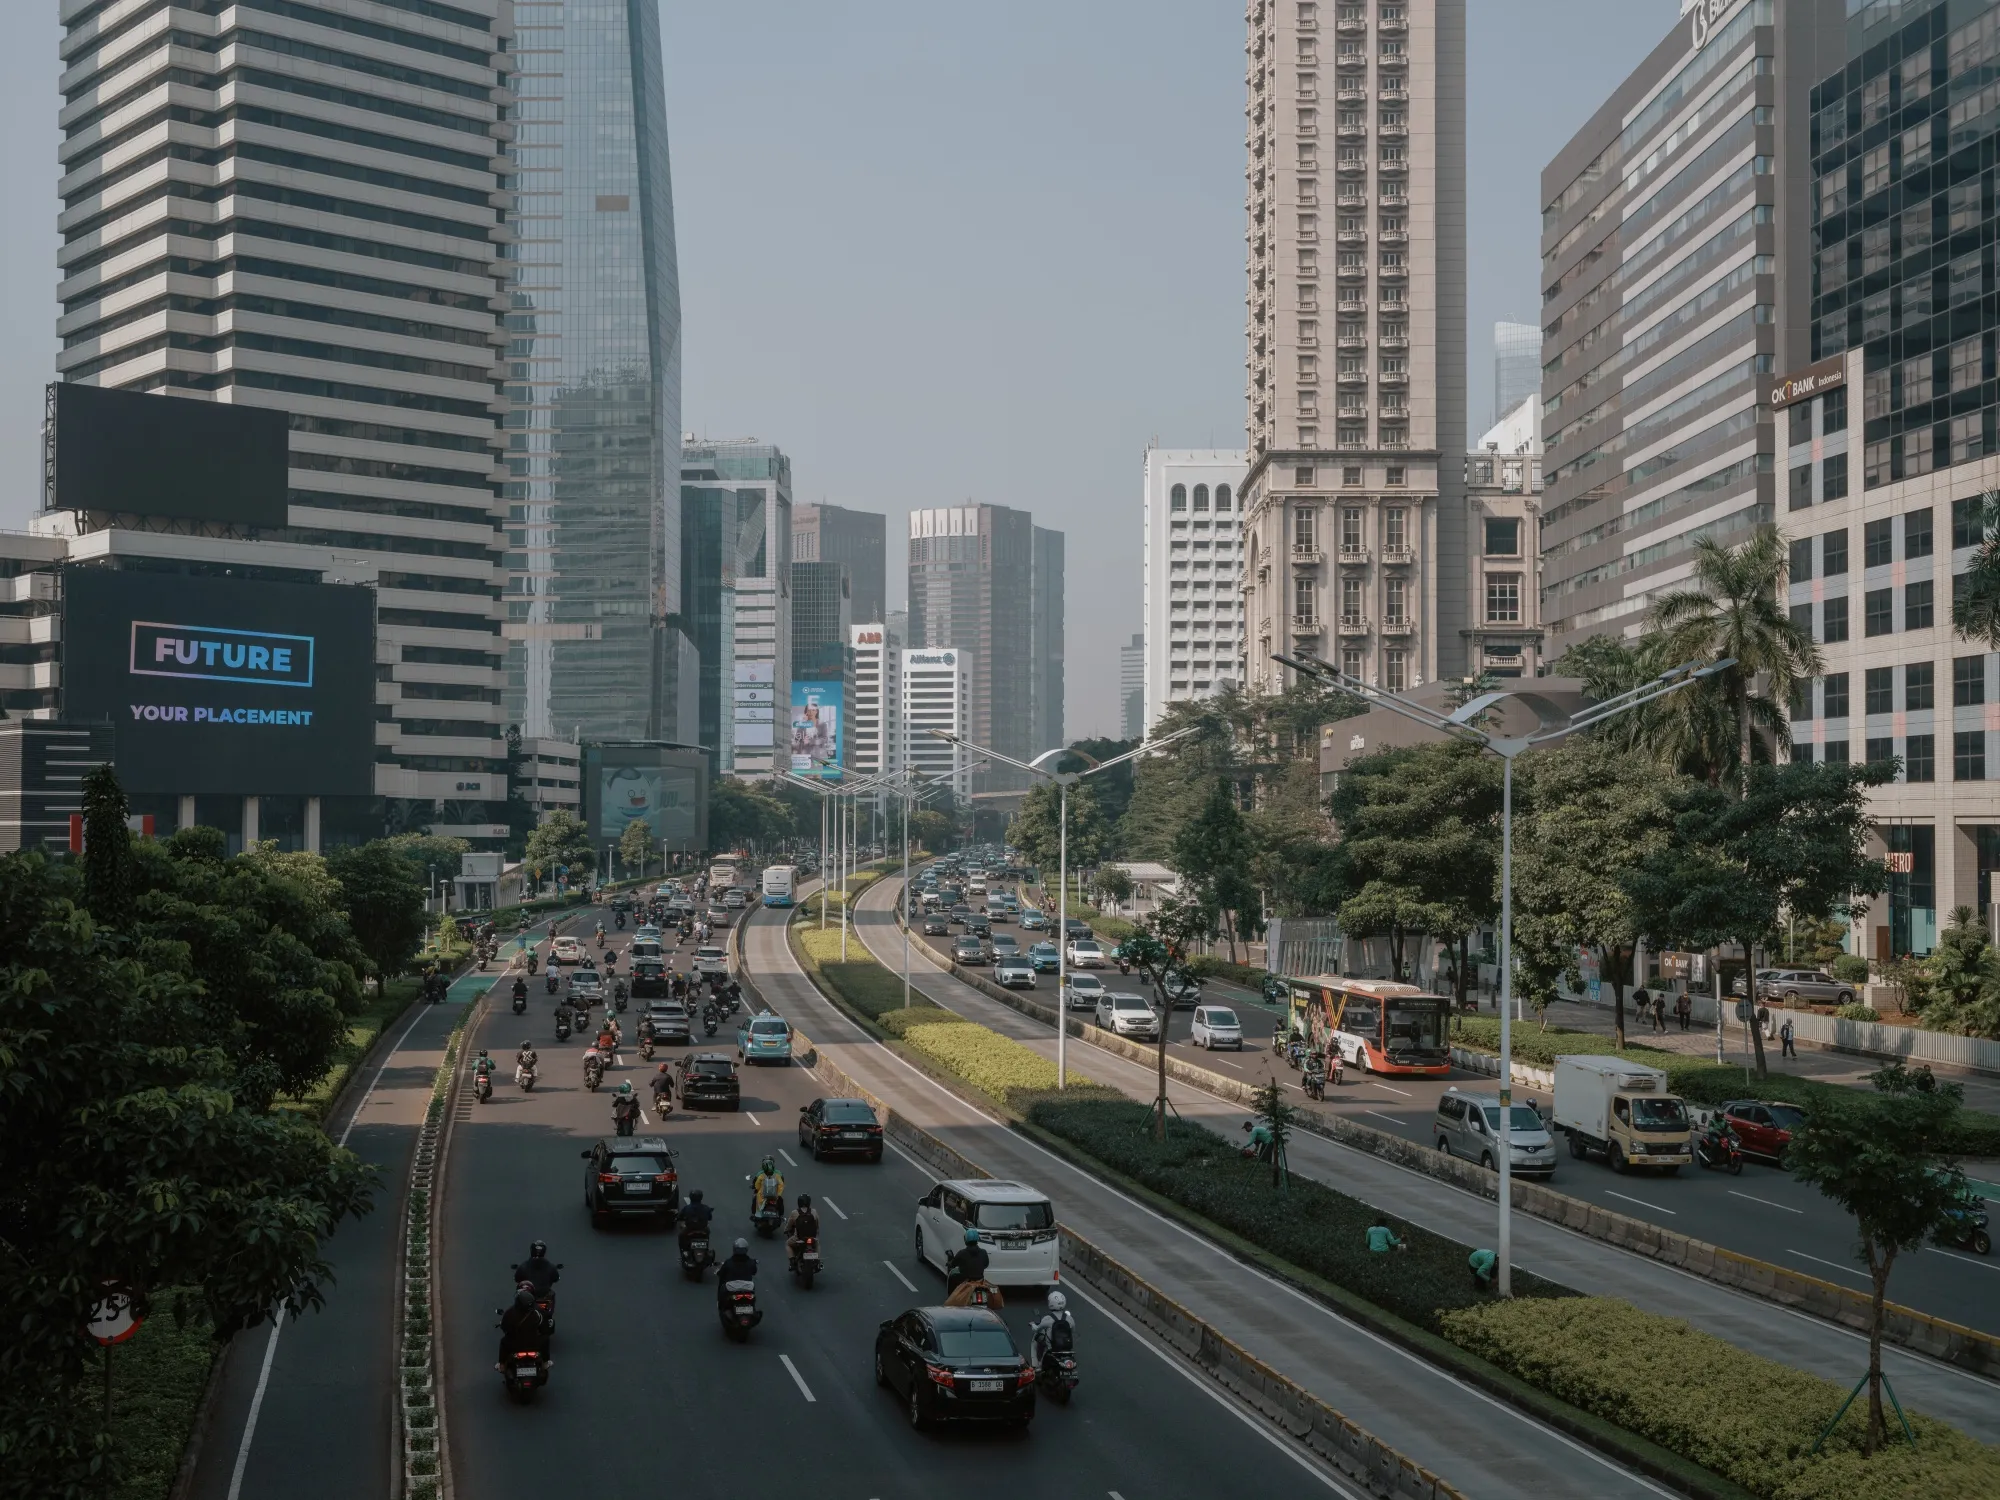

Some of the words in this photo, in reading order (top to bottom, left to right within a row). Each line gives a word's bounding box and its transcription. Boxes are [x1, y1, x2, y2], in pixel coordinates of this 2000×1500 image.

[1771, 387, 1786, 404] OK
[1792, 376, 1815, 397] BANK
[1818, 370, 1842, 387] Indonesia
[857, 632, 883, 644] ABB
[155, 637, 292, 672] FUTURE
[910, 654, 943, 664] Allianz
[130, 705, 188, 722] YOUR
[194, 707, 313, 726] PLACEMENT
[1884, 852, 1911, 873] NITRO
[1664, 957, 1672, 967] OK
[1675, 959, 1689, 969] BANK
